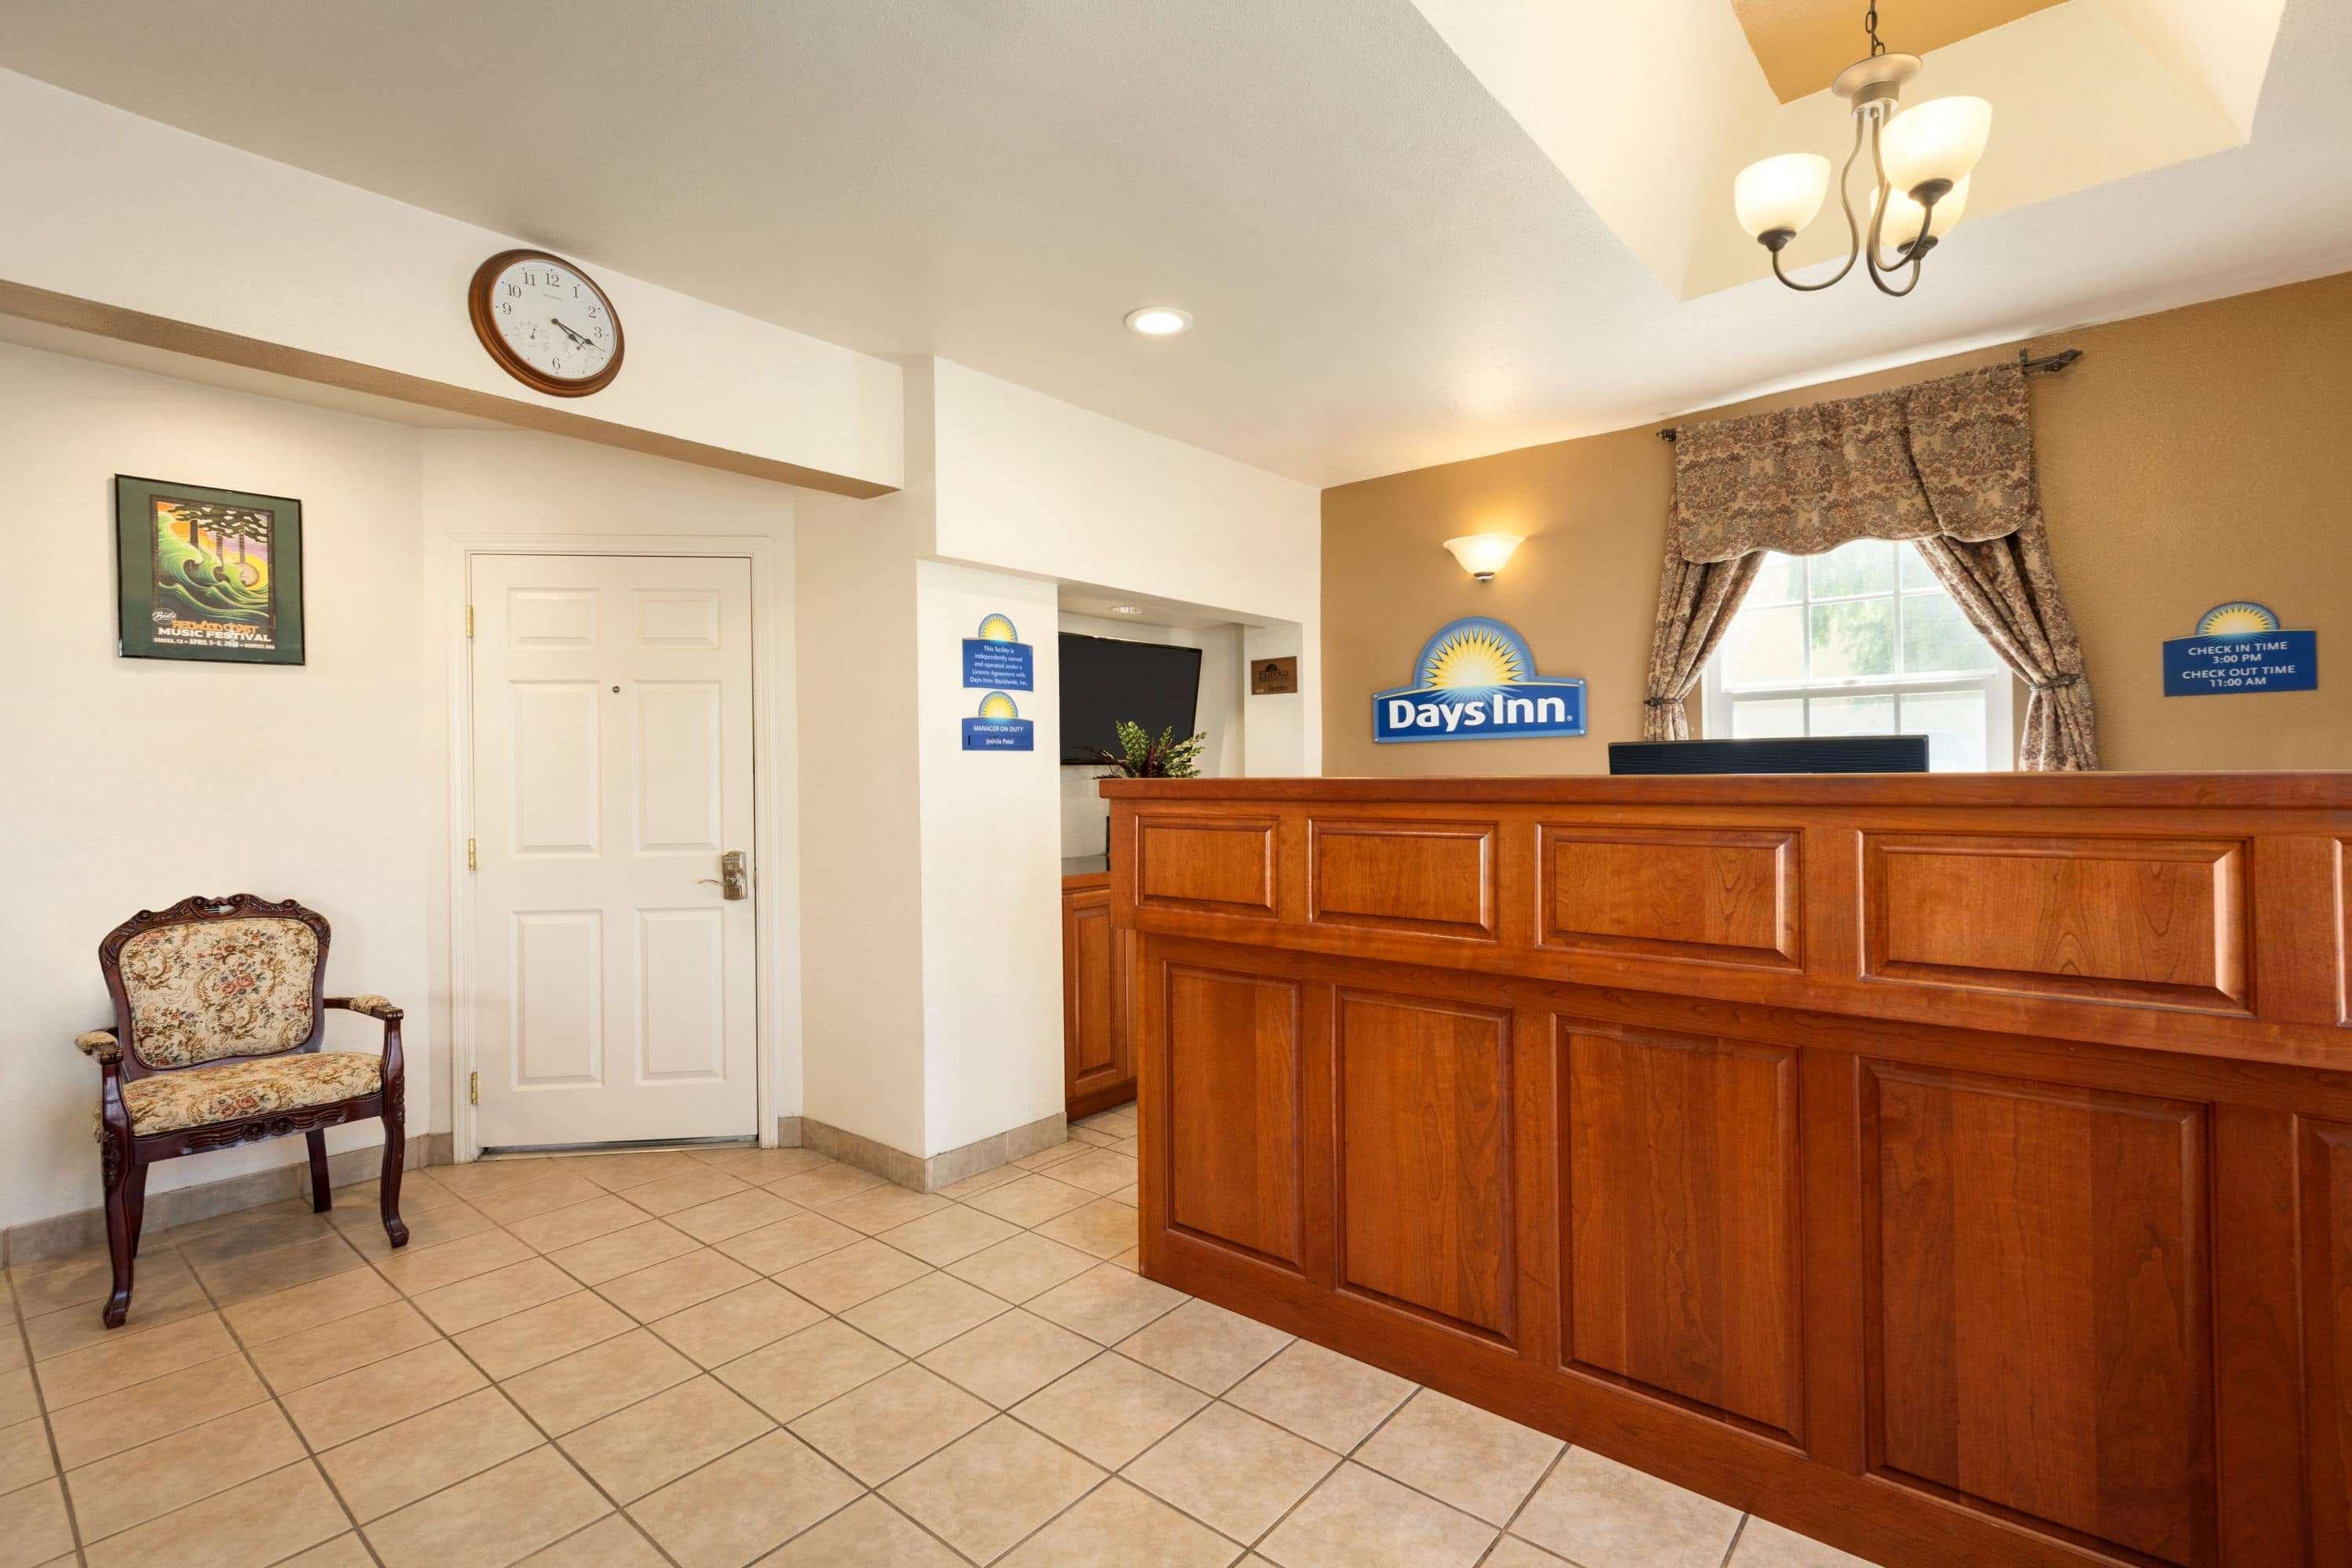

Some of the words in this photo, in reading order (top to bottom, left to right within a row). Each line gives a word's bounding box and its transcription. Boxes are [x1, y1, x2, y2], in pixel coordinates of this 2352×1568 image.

[524, 272, 536, 286] 11
[546, 273, 560, 287] 12
[508, 284, 521, 299] 10
[572, 286, 579, 299] 1
[503, 302, 512, 314] 9
[588, 306, 597, 318] 2
[594, 326, 602, 339] 3
[552, 357, 561, 370] 6
[158, 627, 203, 637] MUSIC
[206, 630, 272, 642] FESTIVAL
[994, 646, 1009, 655] facility
[2188, 645, 2231, 655] CHECK
[2236, 644, 2250, 652] IN
[2254, 641, 2288, 651] TIME
[975, 652, 1007, 662] independently
[2212, 655, 2238, 664] 3:00
[2242, 653, 2262, 662] PM
[2182, 669, 2226, 679] CHECK
[2229, 667, 2258, 677] OUT
[2261, 665, 2296, 674] TIME
[2209, 678, 2242, 688] 11:00
[2245, 677, 2267, 686] AM
[1388, 699, 1486, 732] Days
[1493, 694, 1565, 725] Inn
